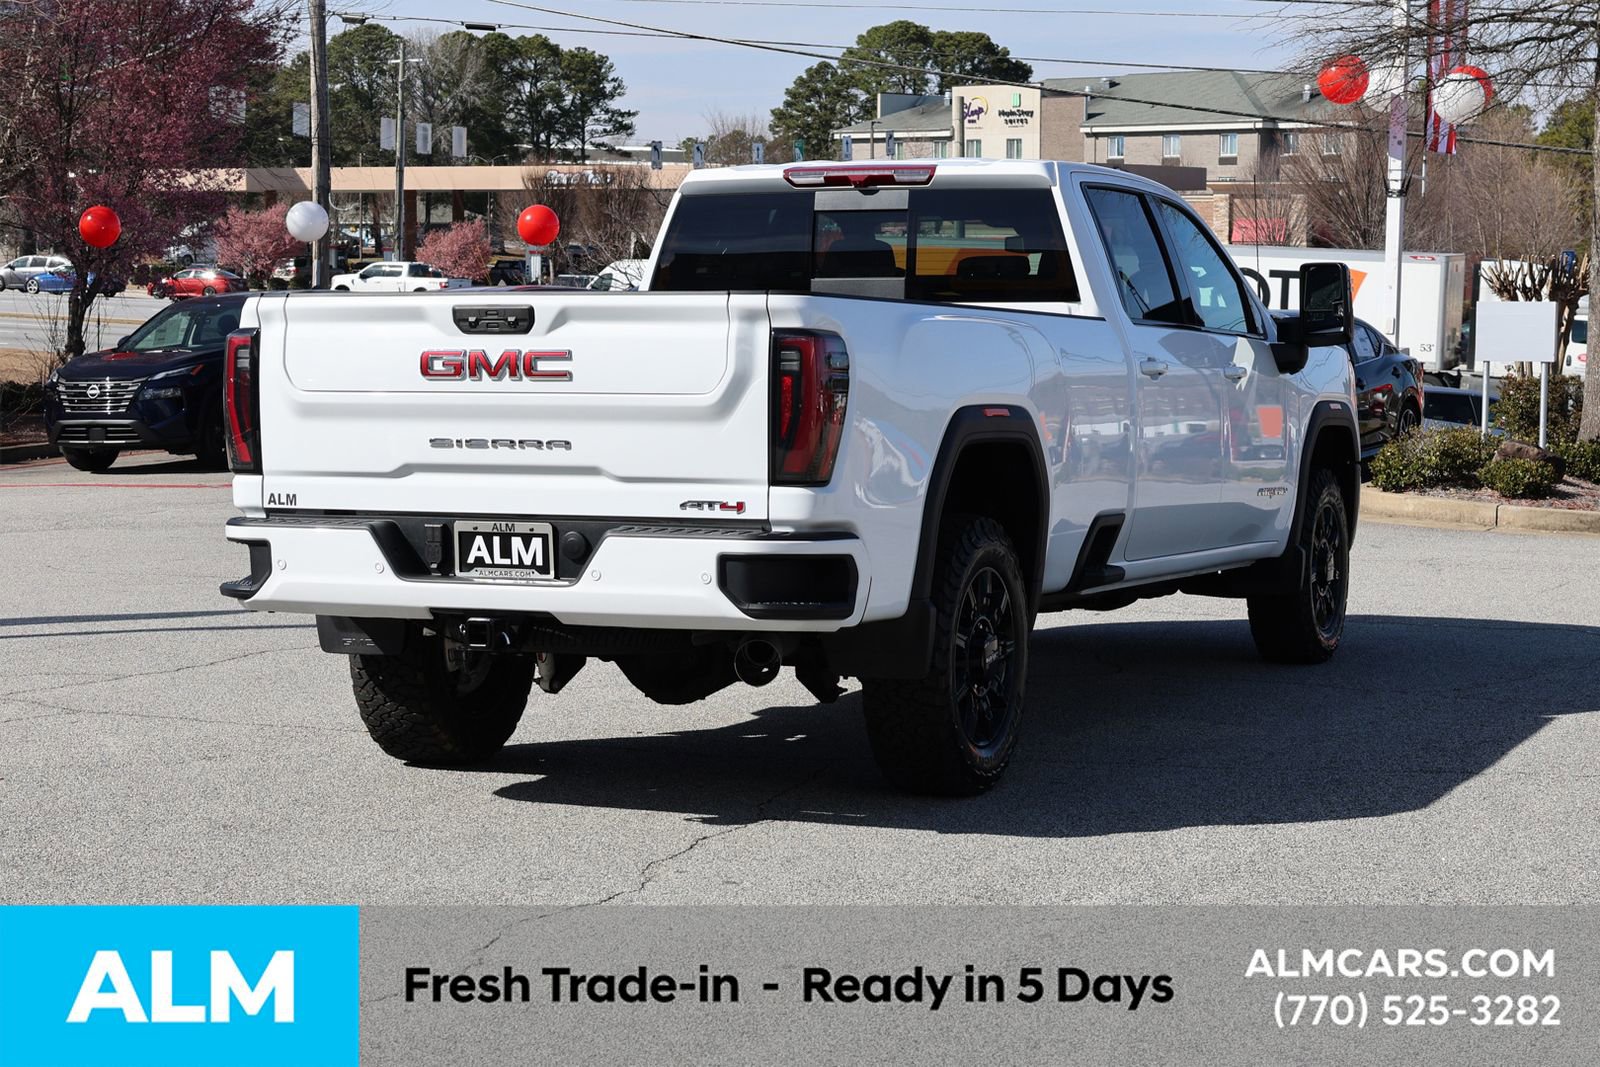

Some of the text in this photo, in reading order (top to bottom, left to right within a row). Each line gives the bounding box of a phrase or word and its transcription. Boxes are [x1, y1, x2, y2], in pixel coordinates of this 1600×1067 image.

[419, 349, 574, 382] GMC
[429, 437, 573, 451] SIERRA
[267, 493, 297, 507] ALM
[679, 500, 747, 515] AT4
[491, 522, 516, 533] ALM
[466, 534, 544, 567] ALM
[478, 568, 532, 578] ALMCARS.COM
